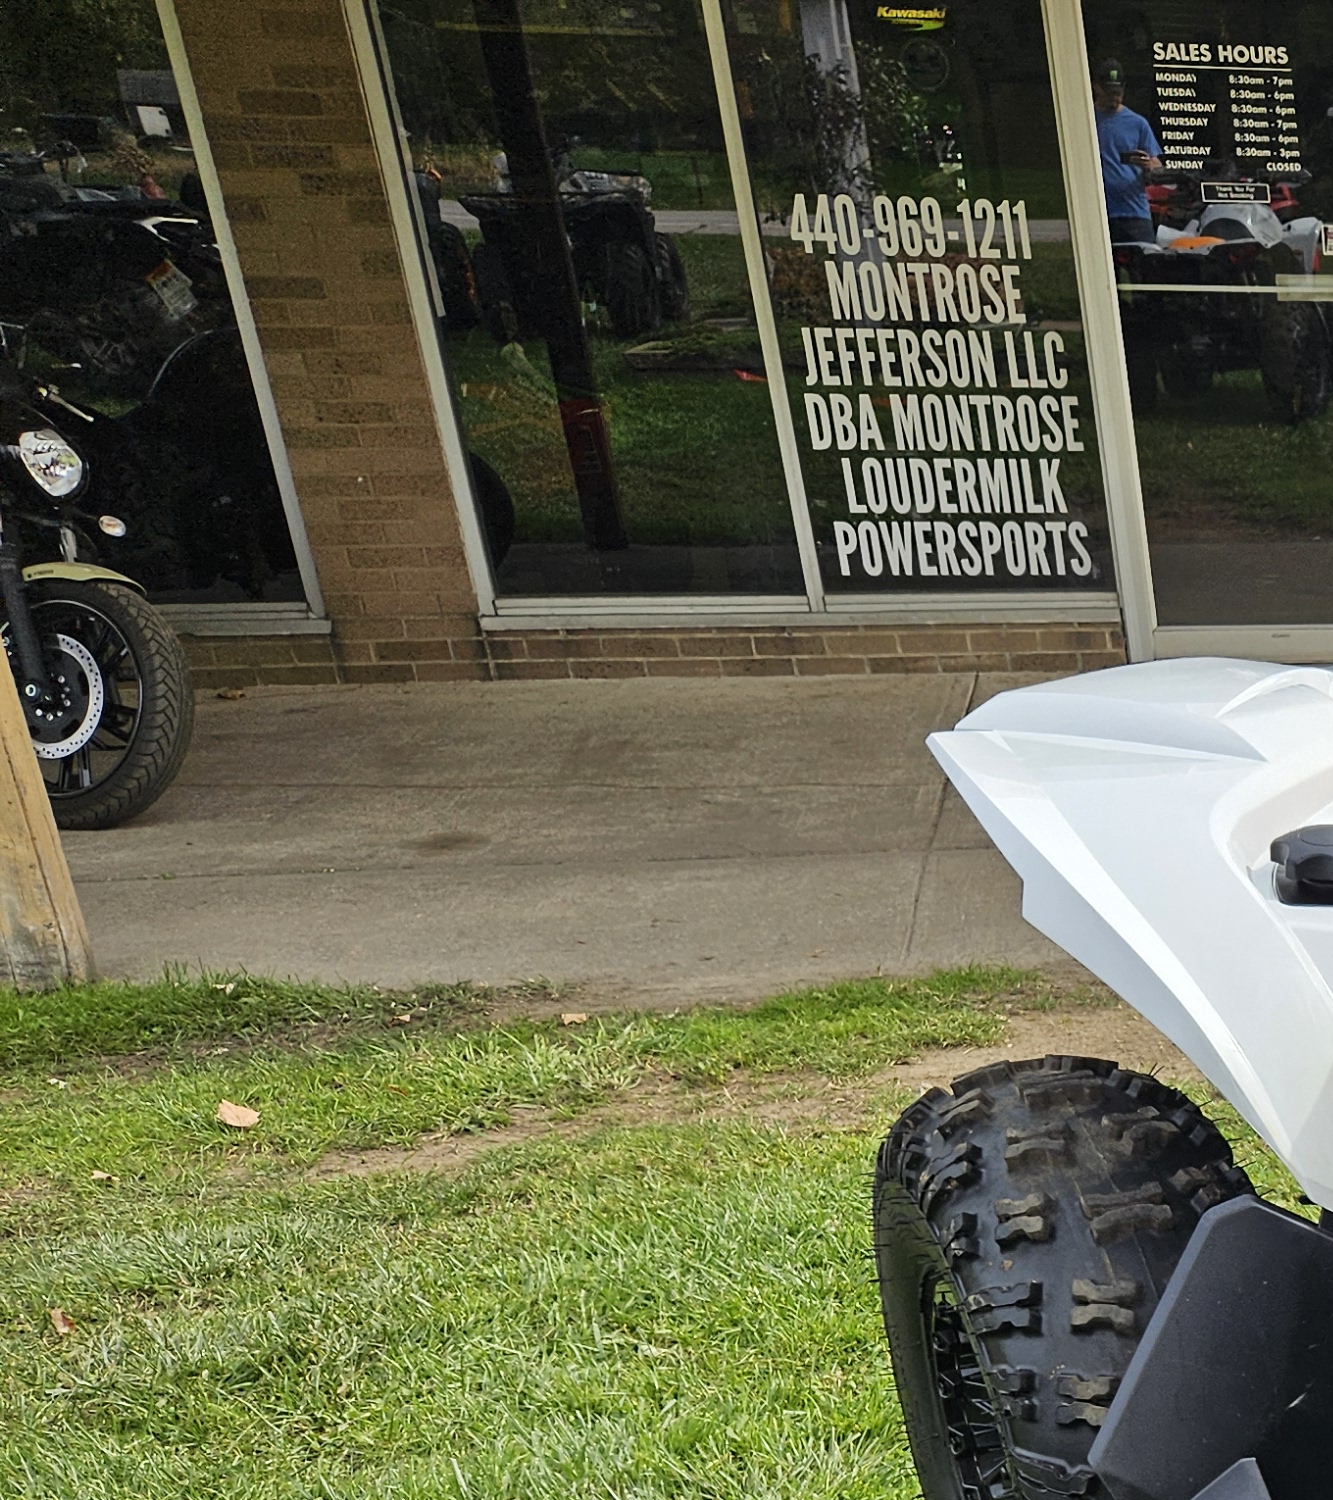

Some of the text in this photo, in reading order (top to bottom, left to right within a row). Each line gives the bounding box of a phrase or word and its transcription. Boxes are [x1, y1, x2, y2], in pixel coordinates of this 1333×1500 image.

[877, 6, 947, 19] Kawasaki
[1153, 42, 1289, 65] SALES HOURS
[1229, 74, 1265, 85] 8:30am
[1272, 76, 1293, 87] 7pm
[1230, 89, 1265, 99] 8:30am
[1273, 91, 1295, 102] 6pm
[1158, 102, 1216, 112] WEDNESDAY
[1231, 104, 1267, 114] 8:30am
[1275, 105, 1296, 116] 6pm
[1160, 117, 1208, 127] THURSDAY
[1233, 118, 1269, 129] 8:30am
[1277, 119, 1297, 131] 7pm
[1162, 131, 1195, 140] FRIDAY
[1234, 133, 1270, 143] 8:30am
[1278, 134, 1299, 145] 6pm
[1163, 145, 1211, 155] SATURDAY
[1236, 147, 1271, 157] 8:30am
[1279, 148, 1300, 159] 3pm
[1165, 160, 1302, 172] SUNDAY CLOSED
[790, 193, 1032, 260] 440-969-1211
[824, 261, 1027, 324] MONTROSE
[801, 327, 1069, 389] JEFFERSON LLC
[804, 393, 1085, 452] DBA MONTROSE
[840, 457, 1068, 514] LOUDERMILK
[833, 521, 1092, 577] POWERSPORTS
